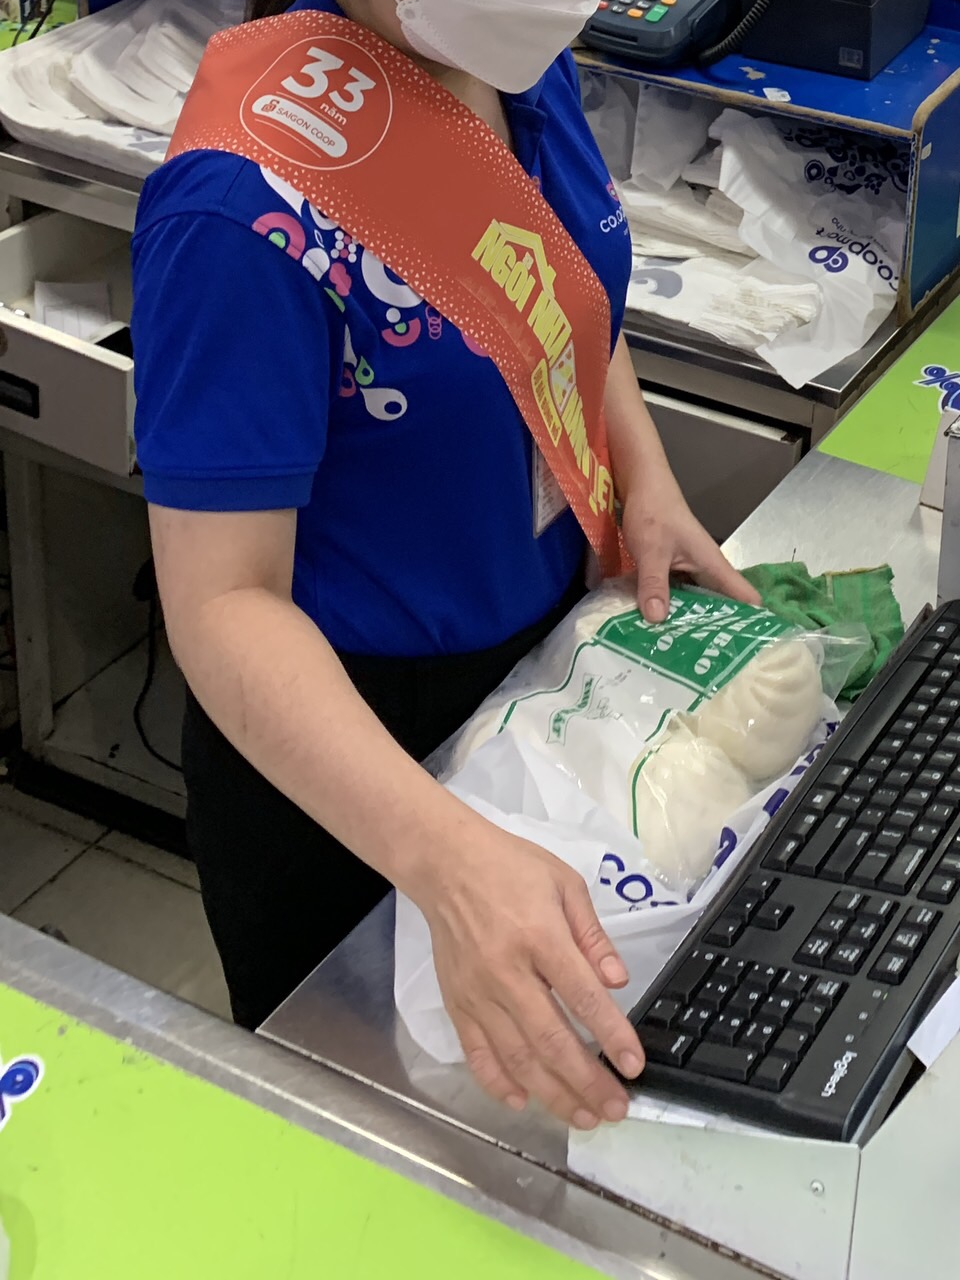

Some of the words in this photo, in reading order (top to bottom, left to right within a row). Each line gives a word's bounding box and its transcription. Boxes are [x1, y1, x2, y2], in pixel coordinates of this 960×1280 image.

[281, 46, 377, 112] 33
[276, 107, 311, 131] SAIGON
[320, 102, 347, 126] năm
[820, 1050, 858, 1098] logitech
